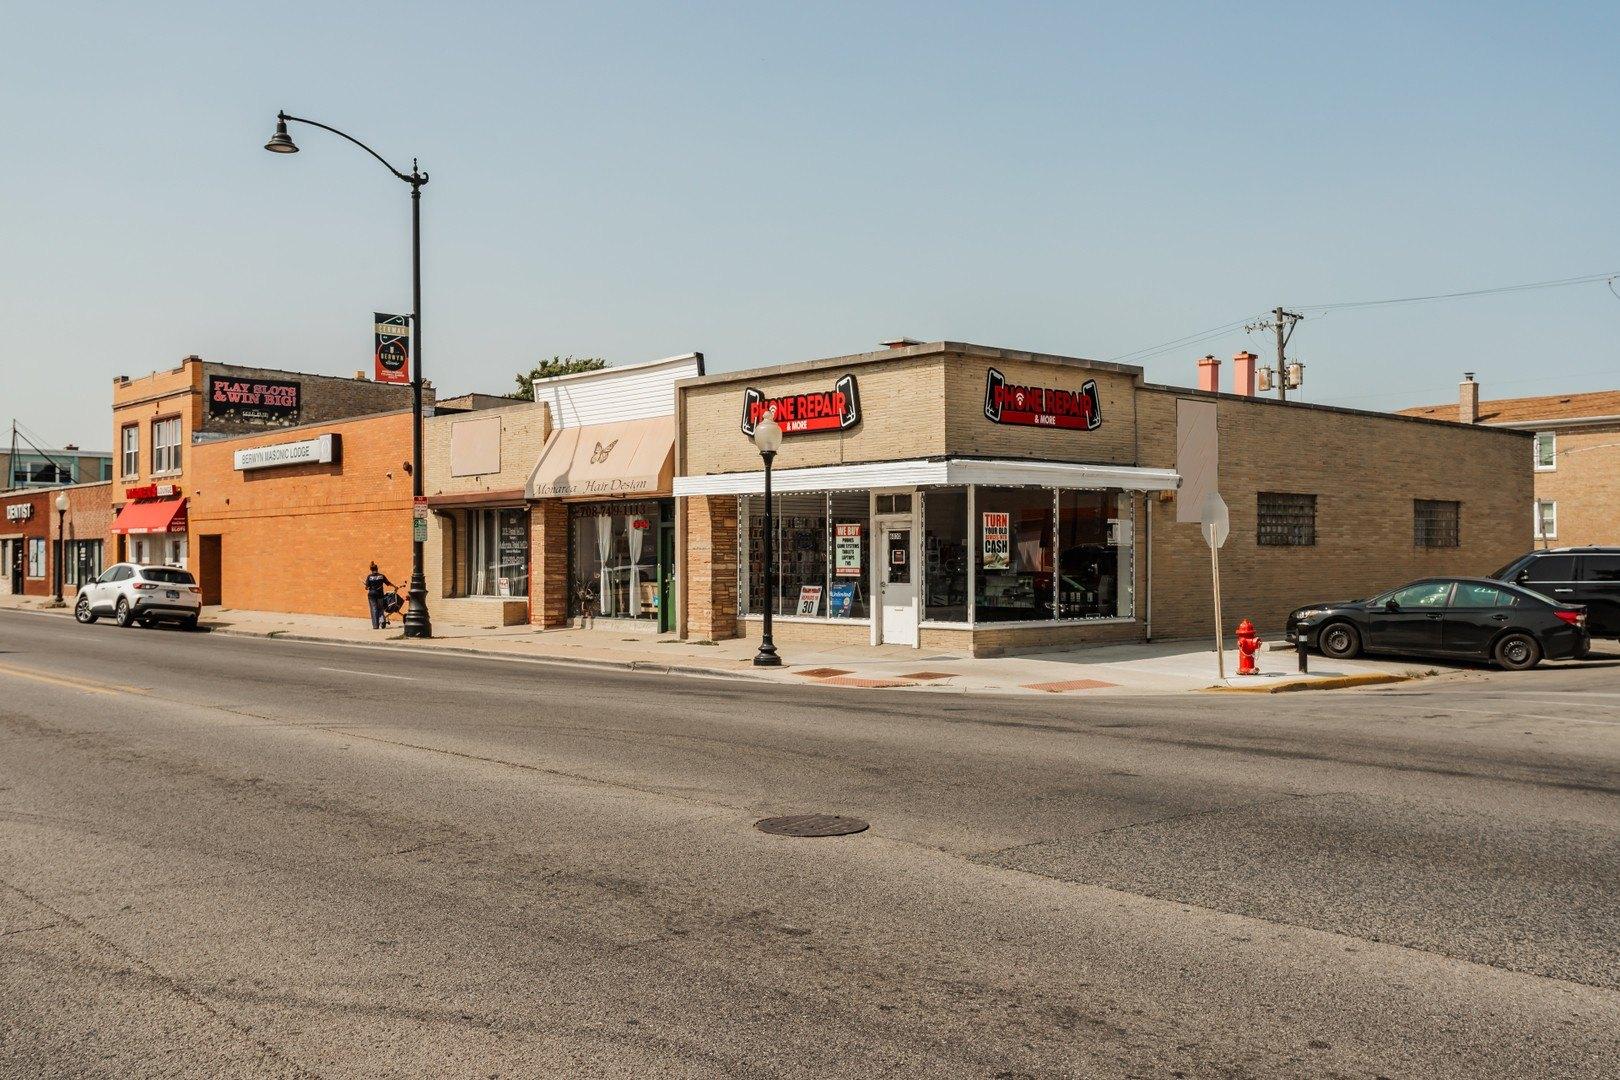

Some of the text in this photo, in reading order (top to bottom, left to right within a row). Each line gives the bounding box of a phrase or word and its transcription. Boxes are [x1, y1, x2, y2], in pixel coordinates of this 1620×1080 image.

[214, 381, 296, 397] PLAY SLOTS
[264, 394, 296, 407] BIG!
[750, 391, 847, 424] PHONE REPAIR
[994, 384, 1092, 418] PHONE REPAIR
[786, 420, 808, 431] & MORE
[1034, 414, 1056, 425] & MORE
[242, 445, 310, 465] BERWYN MASONIC LODGE
[583, 479, 609, 494] Hair
[611, 478, 647, 491] Design
[6, 502, 31, 520] DENTIST
[985, 514, 1007, 527] TURN
[837, 526, 860, 536] WE BUY
[985, 527, 1007, 535] YOUR OLD
[985, 539, 1007, 553] CASH
[802, 600, 814, 614] 30
